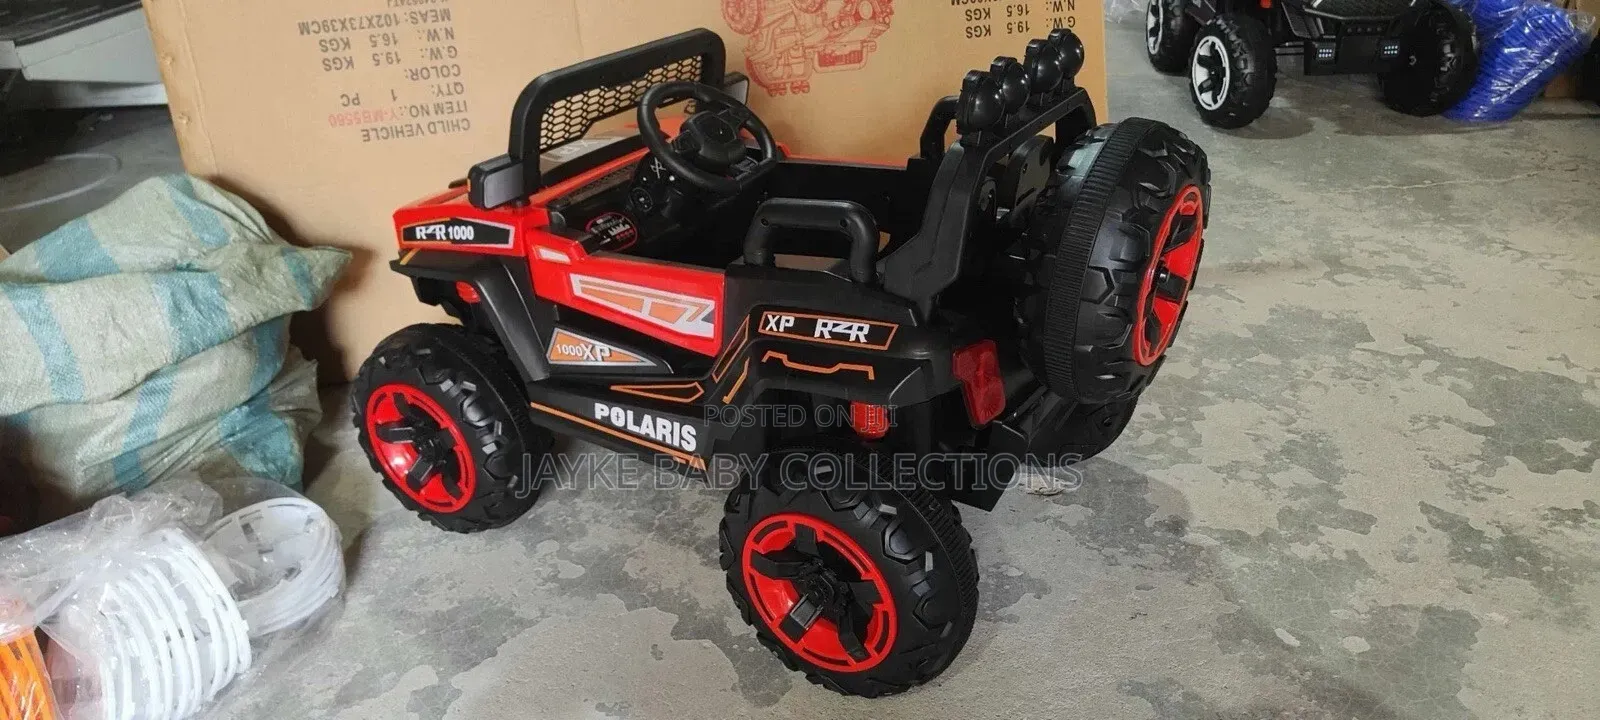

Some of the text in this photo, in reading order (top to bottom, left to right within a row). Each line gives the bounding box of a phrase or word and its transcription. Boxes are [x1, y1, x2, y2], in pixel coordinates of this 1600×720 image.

[965, 8, 991, 21] KGS
[1006, 4, 1030, 17] 16.5
[298, 8, 452, 36] MEAS: 102X73X39CM
[1006, 21, 1030, 34] 19.5
[318, 27, 455, 53] N.W.: 16.5 KGS
[965, 25, 992, 39] KGS
[322, 45, 458, 72] G.W.: 19.5 KGS
[404, 63, 462, 81] COLOR:
[340, 81, 465, 107] QTY: 1 PC
[434, 100, 468, 112] ITEM
[360, 117, 471, 143] CHILD VEHICLE
[447, 225, 475, 241] 1000
[765, 314, 796, 333] XP
[594, 402, 697, 452] POLARIS
